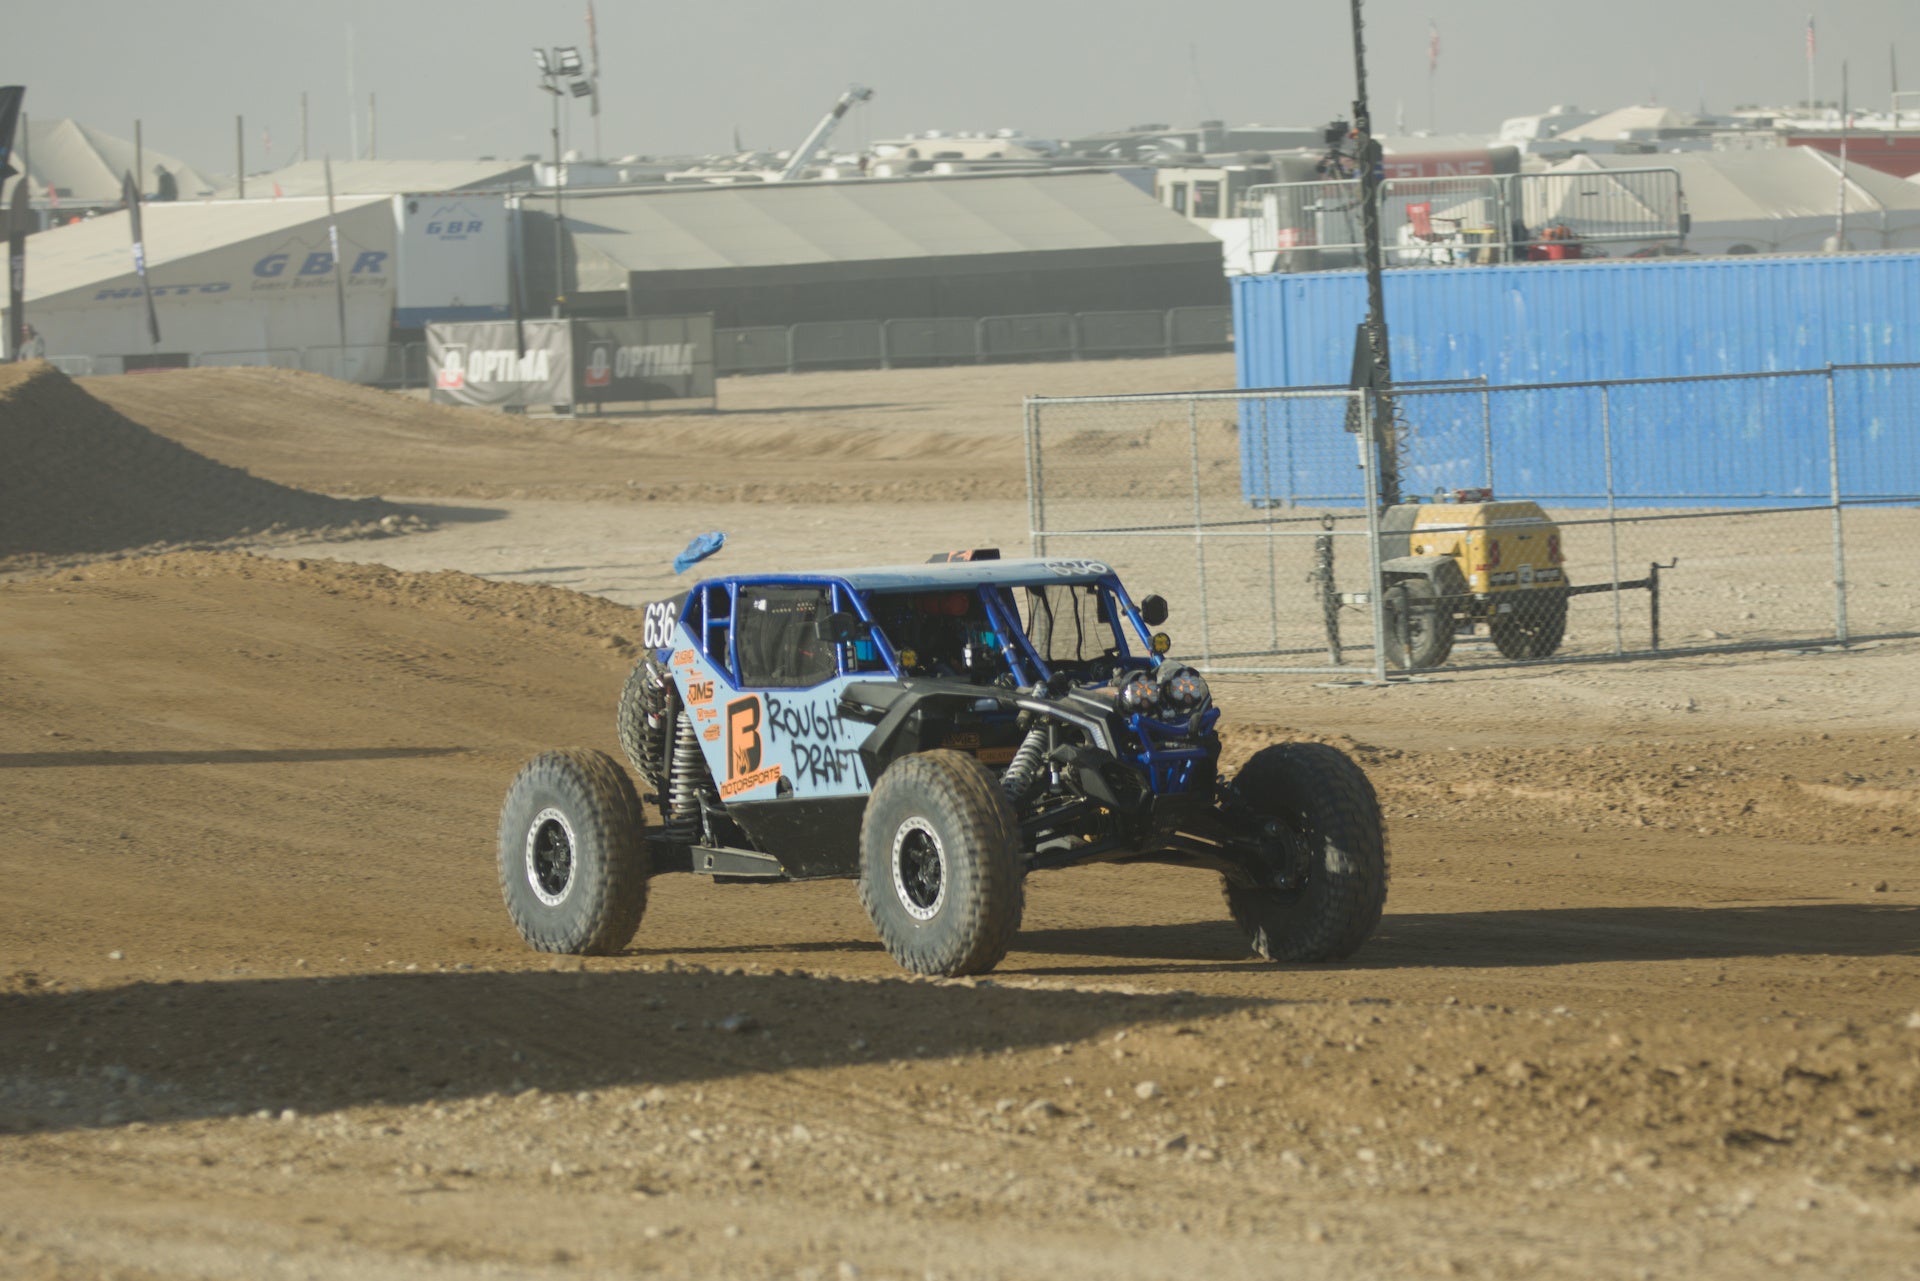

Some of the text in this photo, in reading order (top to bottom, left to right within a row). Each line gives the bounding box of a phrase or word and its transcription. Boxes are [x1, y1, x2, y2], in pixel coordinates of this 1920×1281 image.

[426, 220, 483, 234] GBR
[253, 251, 388, 278] GBR
[469, 350, 549, 383] OPTIMA
[615, 344, 697, 378] OPTIMA
[644, 602, 676, 648] 636
[764, 692, 844, 742] ROUGH
[721, 766, 781, 796] MOTORSPORTS
[791, 740, 862, 790] DRAFT
